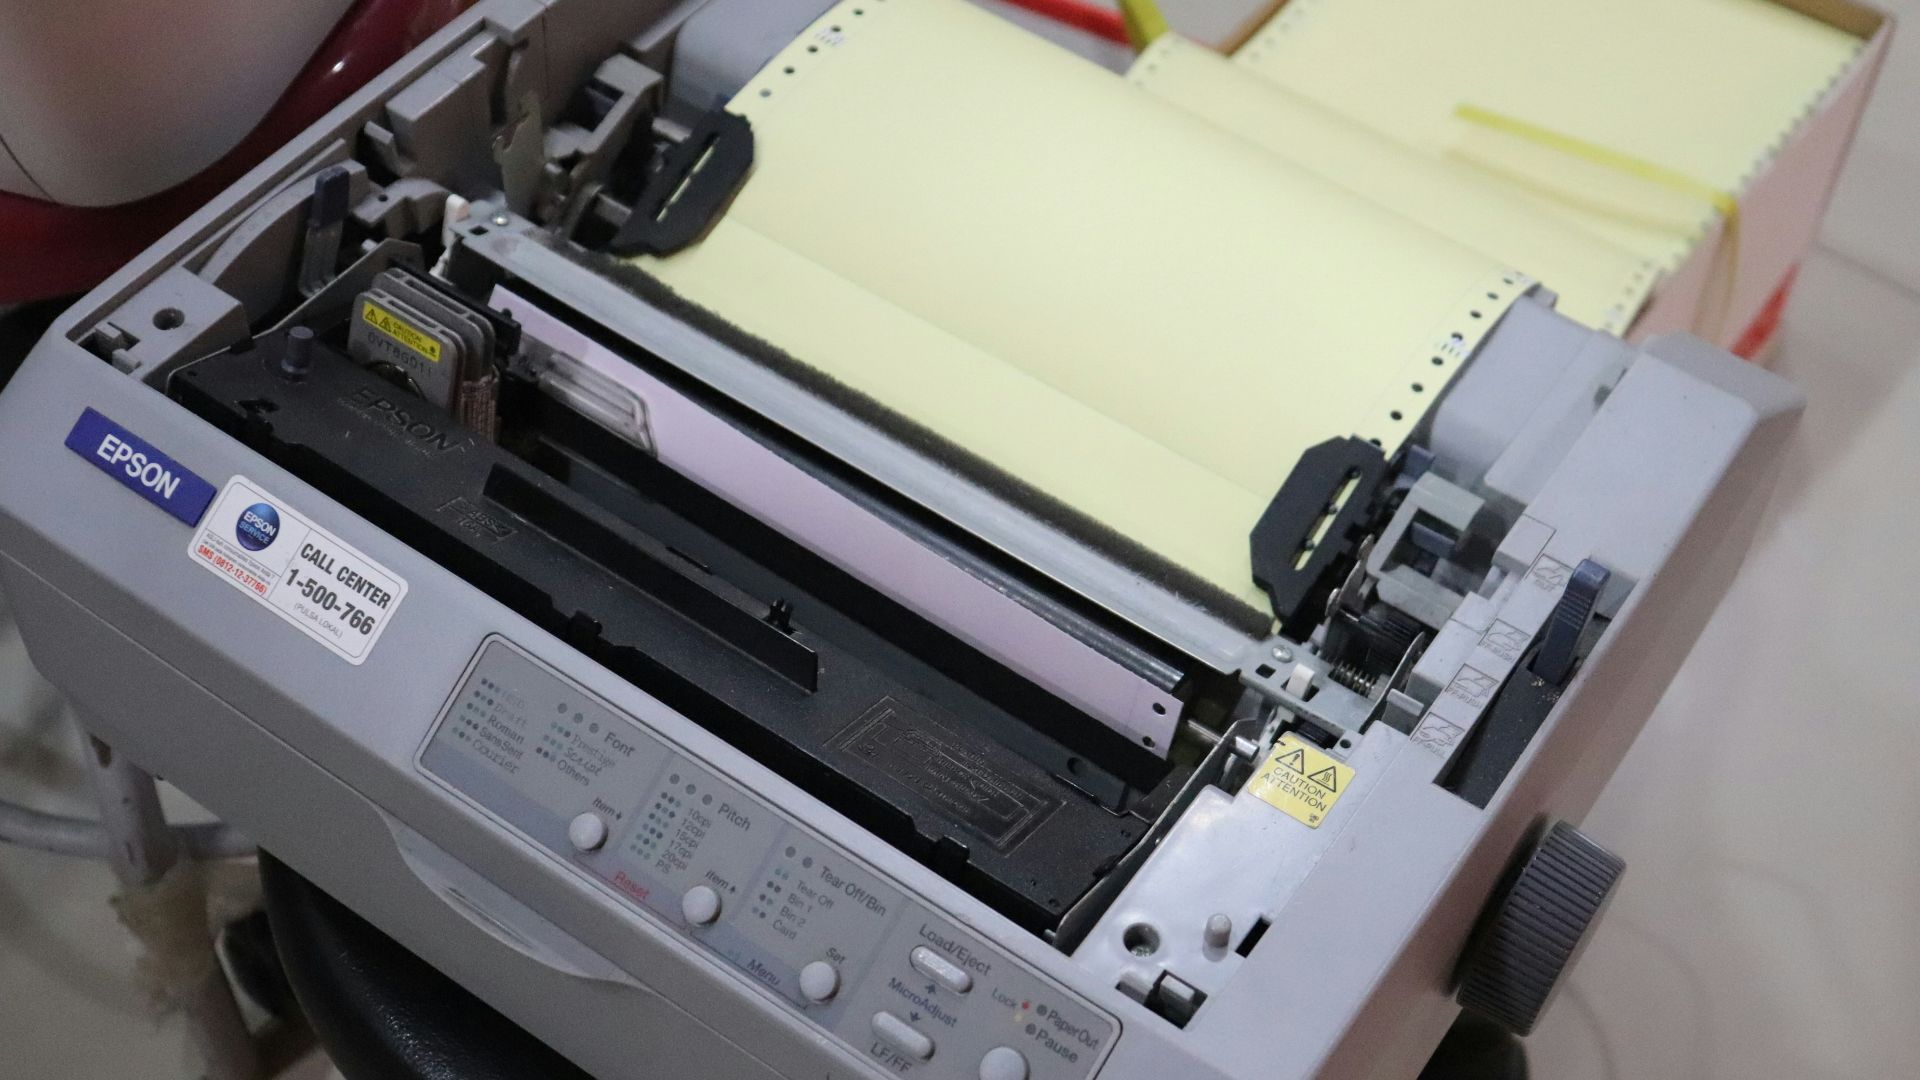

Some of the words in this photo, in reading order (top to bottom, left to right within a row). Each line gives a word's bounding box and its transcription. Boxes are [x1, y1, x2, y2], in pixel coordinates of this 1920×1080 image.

[353, 387, 460, 450] EPSON
[97, 434, 180, 499] EPSON
[239, 521, 270, 544] SERVICE
[243, 511, 276, 536] EPSON
[198, 544, 214, 560] SMS
[301, 544, 334, 575] CALL
[336, 566, 391, 609] CENTER
[286, 569, 375, 634] 1-500-766
[294, 602, 318, 622] (PULSA
[318, 619, 343, 638] LOKAL)
[488, 714, 524, 744] Roman
[472, 739, 520, 774] Courier
[604, 732, 636, 757] Font
[557, 759, 590, 786] Others
[1274, 766, 1326, 800] CAUTION
[592, 796, 615, 816] Item
[1260, 772, 1328, 812] ATTENTION
[682, 818, 706, 840] 12cpi
[688, 808, 711, 829] 10cpi
[718, 802, 751, 831] Pitch
[662, 850, 688, 871] 20cpi
[670, 840, 692, 859] 17cpi
[656, 859, 672, 874] PS
[705, 870, 729, 890] Item
[616, 870, 650, 899] Reset
[797, 880, 817, 898] Tear
[818, 894, 834, 910] Off
[820, 866, 844, 889] Tear
[844, 883, 886, 917] Off/Bin
[788, 893, 804, 908] Bin
[772, 920, 798, 940] Card
[780, 905, 798, 922] Bin
[798, 918, 806, 928] 2
[826, 947, 846, 964] Set
[920, 923, 992, 976] Load/Eject
[747, 958, 782, 986] Menu
[888, 977, 958, 1028] MicroAdjust
[992, 986, 1018, 1010] Lock
[870, 1042, 913, 1072] LF/FF
[1035, 1028, 1079, 1063] Pause
